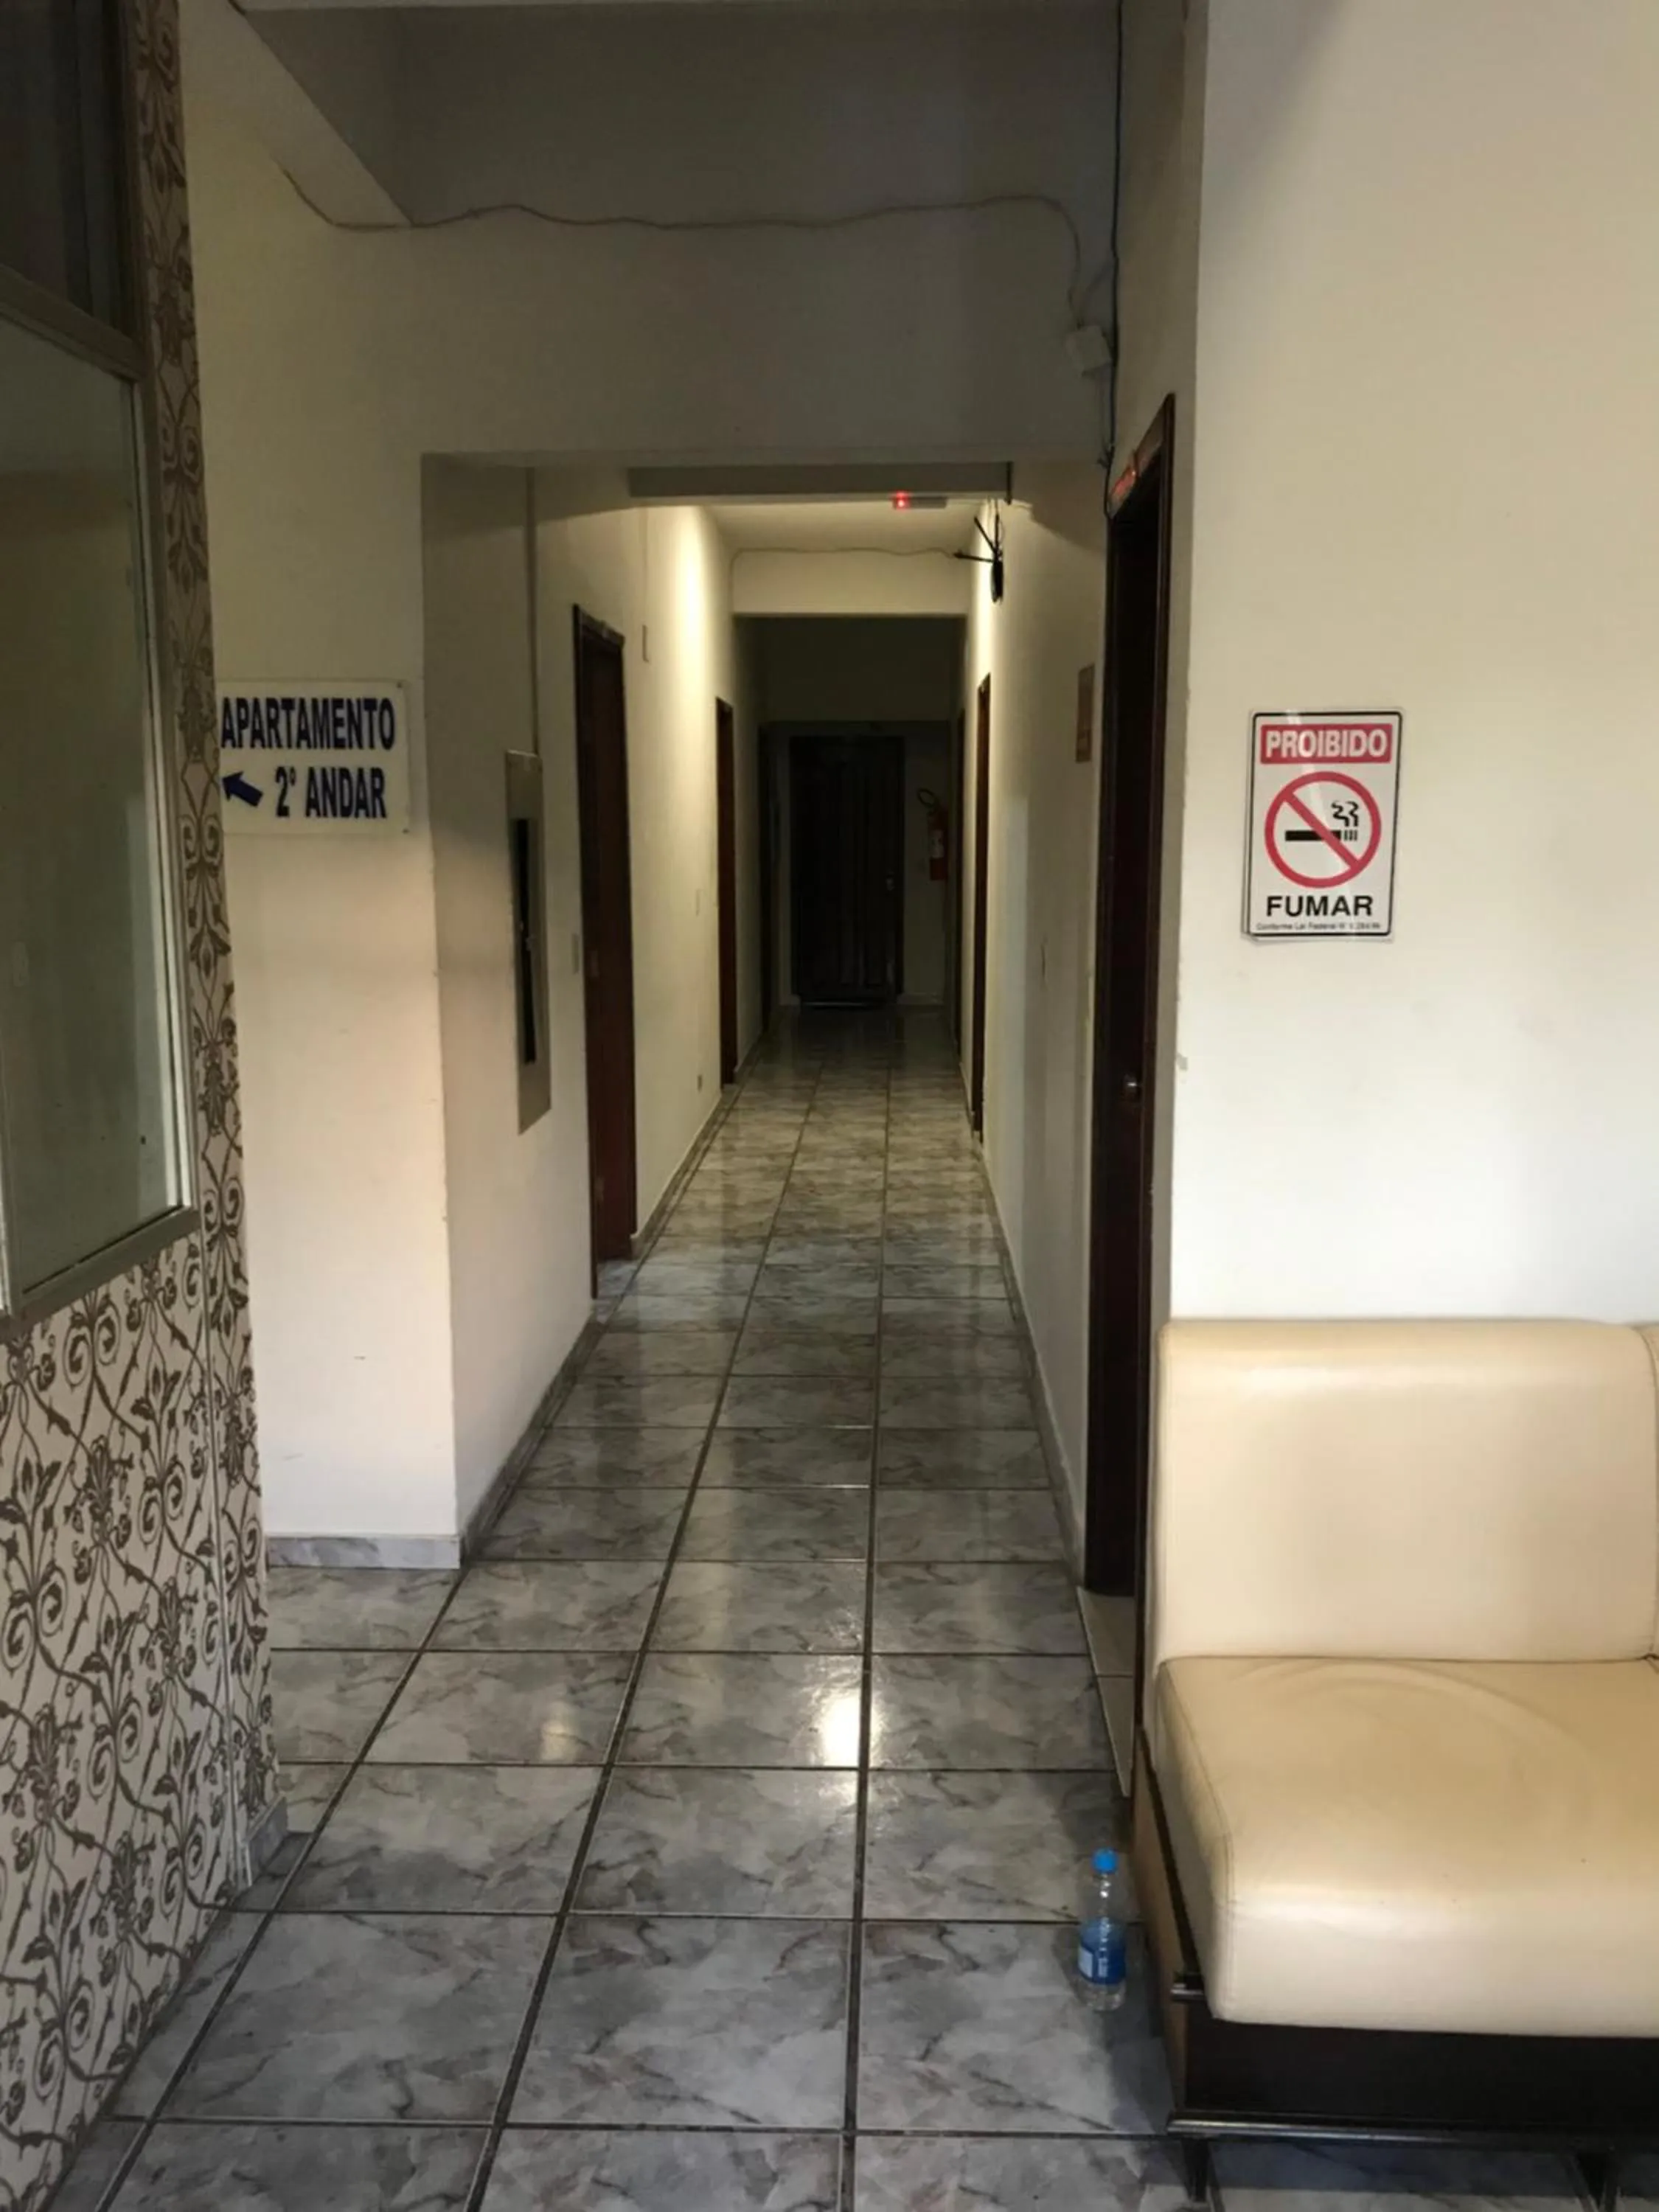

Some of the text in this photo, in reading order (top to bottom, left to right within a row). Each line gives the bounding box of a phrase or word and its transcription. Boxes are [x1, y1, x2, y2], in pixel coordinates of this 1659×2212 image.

[220, 697, 395, 751] APARTAMENTO
[1265, 728, 1388, 759] PROIBIDO
[305, 766, 387, 819] ANDAR
[1265, 895, 1374, 917] FUMAR
